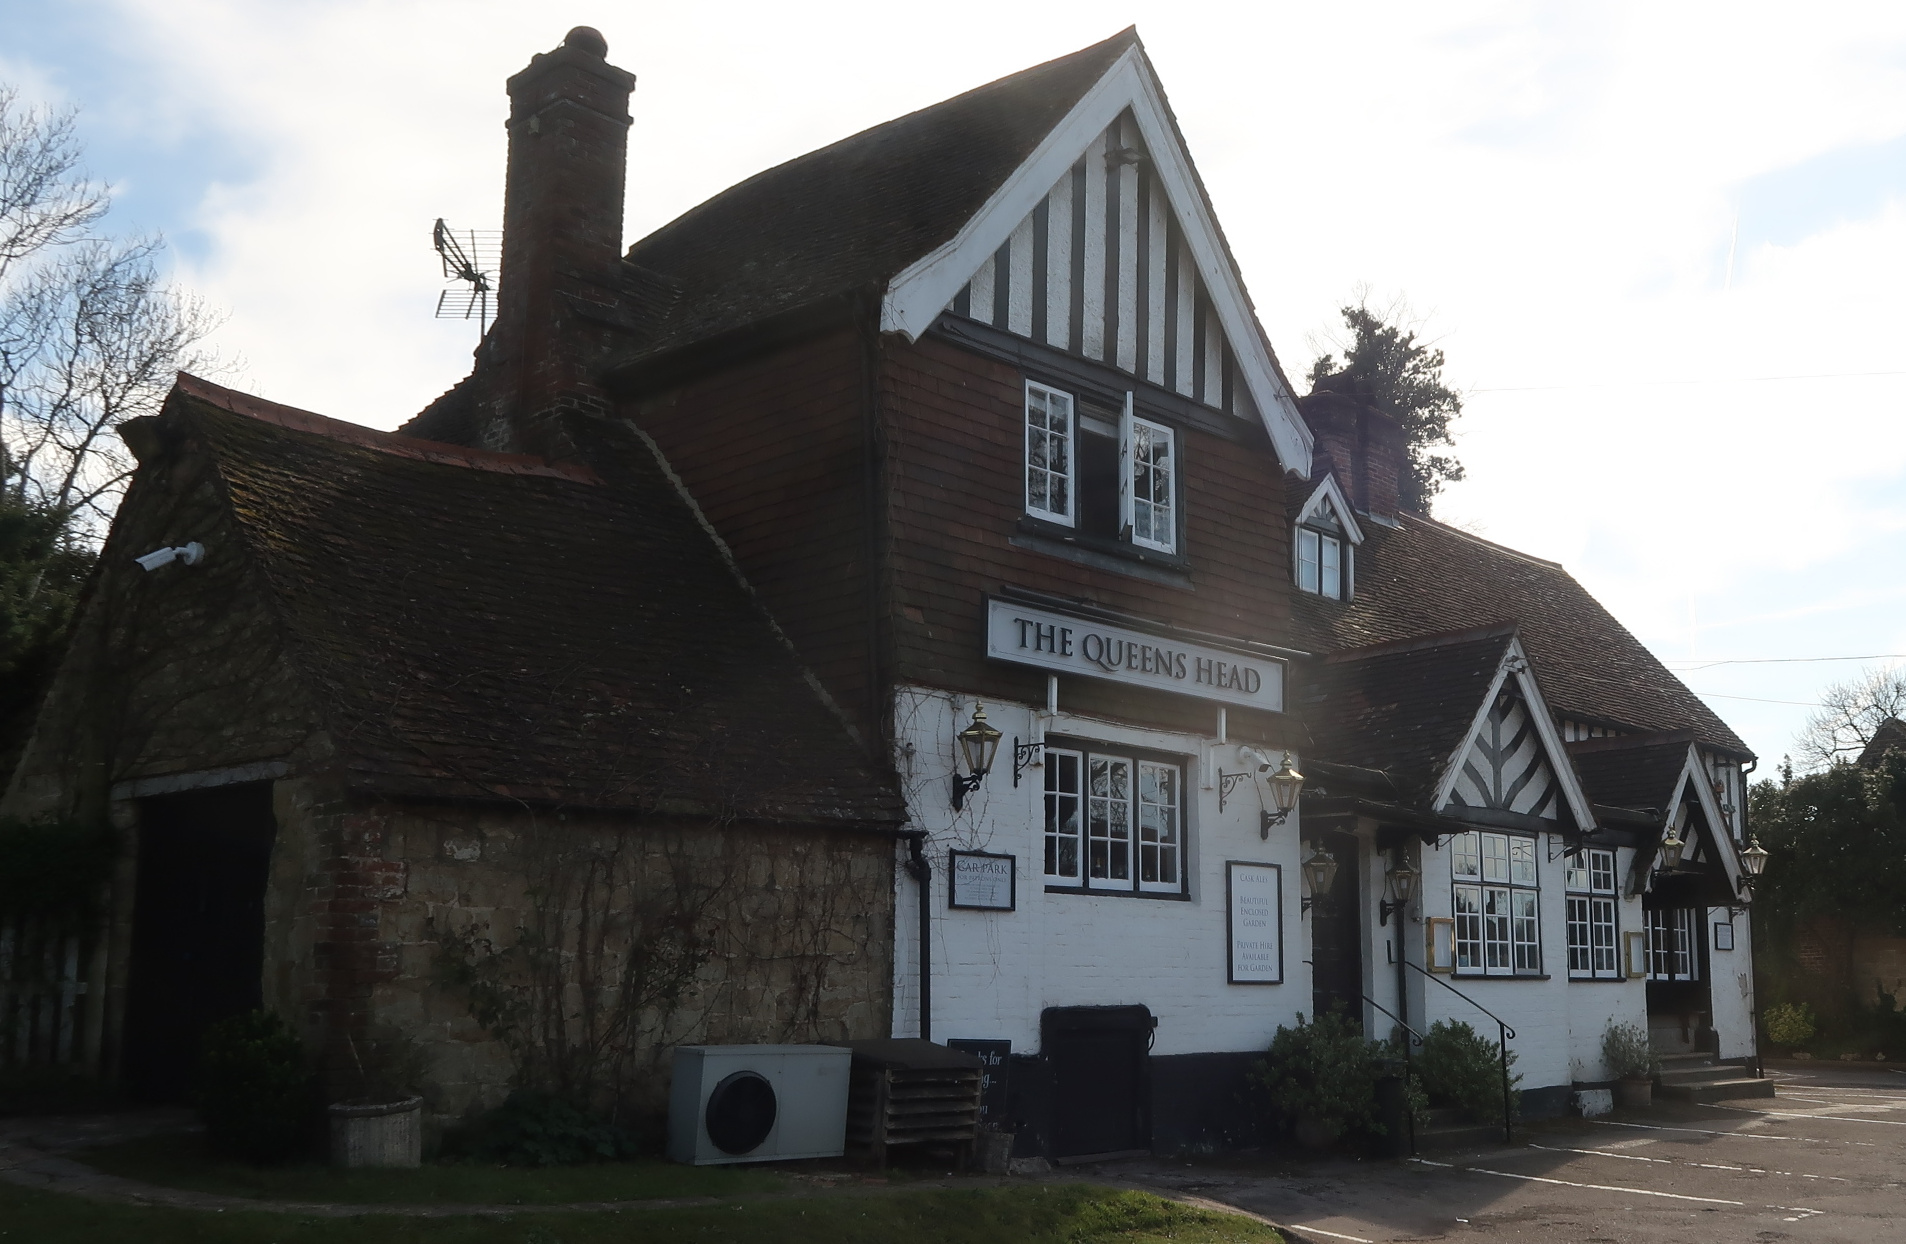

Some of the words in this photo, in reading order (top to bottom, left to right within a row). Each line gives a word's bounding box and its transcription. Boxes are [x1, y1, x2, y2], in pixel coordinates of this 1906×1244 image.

[1014, 617, 1074, 657] THE
[1082, 633, 1188, 680] QUEENS
[1195, 656, 1262, 694] HEAD
[956, 860, 979, 872] CAR
[982, 863, 1008, 874] PARK
[1239, 873, 1254, 882] CASK
[1240, 896, 1269, 906] BEAUTIFUL
[1240, 907, 1269, 917] ENCLOSED
[1243, 919, 1267, 927] GARDEN
[1237, 941, 1258, 949] PRIVATE
[1260, 941, 1273, 949] HIRE
[1241, 952, 1269, 961] AVAILABLE
[1250, 963, 1273, 972] GARDEN
[989, 1050, 1002, 1066] for
